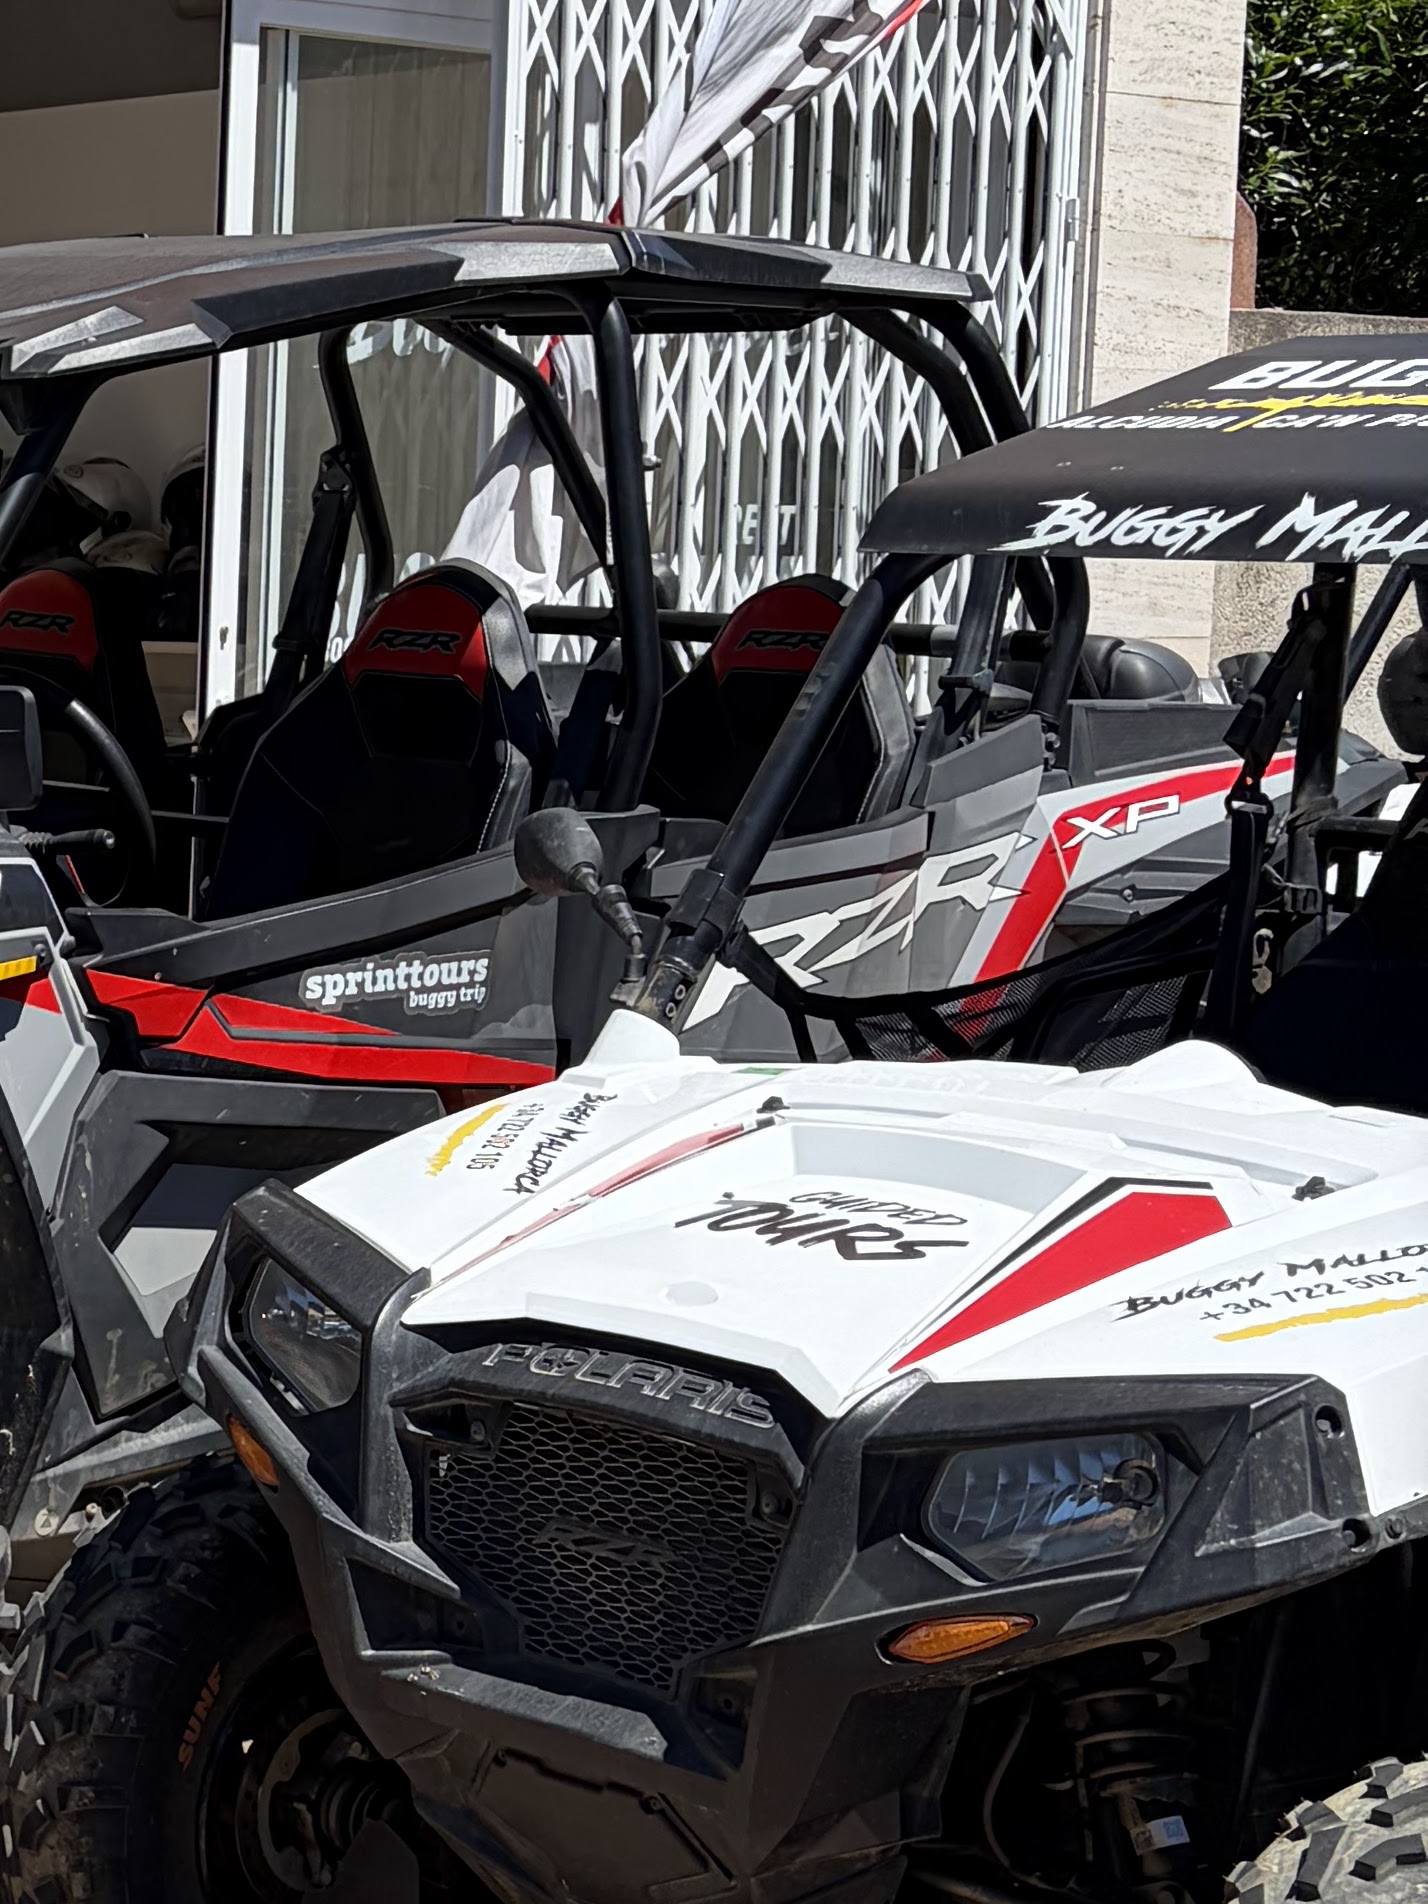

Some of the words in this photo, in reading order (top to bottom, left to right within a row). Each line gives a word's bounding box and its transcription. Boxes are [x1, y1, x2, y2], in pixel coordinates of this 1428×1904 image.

[987, 491, 1265, 557] BUGGY
[367, 628, 466, 653] RZR
[1054, 795, 1183, 851] XP
[304, 957, 489, 1006] sprinttours
[409, 989, 457, 1009] buggy
[503, 1126, 590, 1195] MALLORCA
[674, 1192, 970, 1260] TOURS
[1108, 1271, 1265, 1323] BUGGY
[1270, 1282, 1346, 1304] 722
[1342, 1270, 1418, 1290] 502
[482, 1342, 776, 1429] POLARIS
